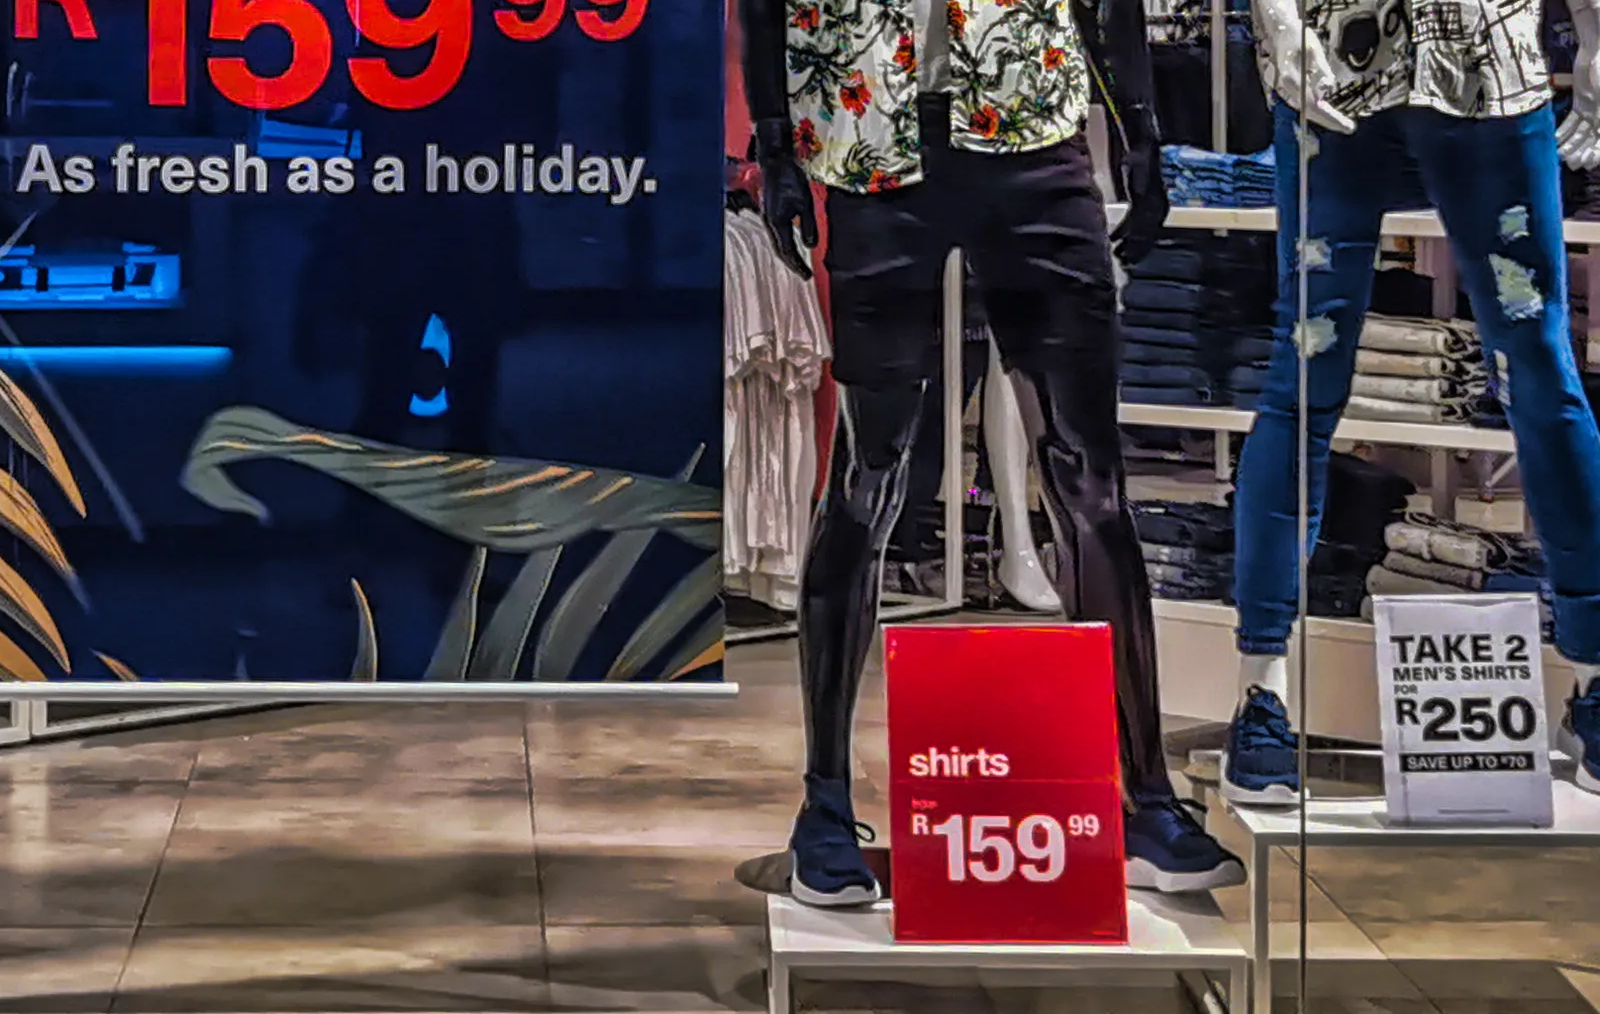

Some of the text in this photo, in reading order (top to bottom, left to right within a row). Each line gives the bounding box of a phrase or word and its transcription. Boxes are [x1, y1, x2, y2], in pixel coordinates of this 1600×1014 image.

[16, 143, 658, 206] As fresh as a holiday.
[1390, 633, 1530, 664] TAKE 2
[1392, 664, 1532, 682] MEN'S SHIRTS
[1394, 684, 1418, 695] FOR
[1394, 695, 1538, 743] R250
[908, 746, 1011, 778] shirts
[1407, 754, 1448, 770] SAVE
[1451, 754, 1474, 769] UP
[1476, 754, 1499, 769] TO
